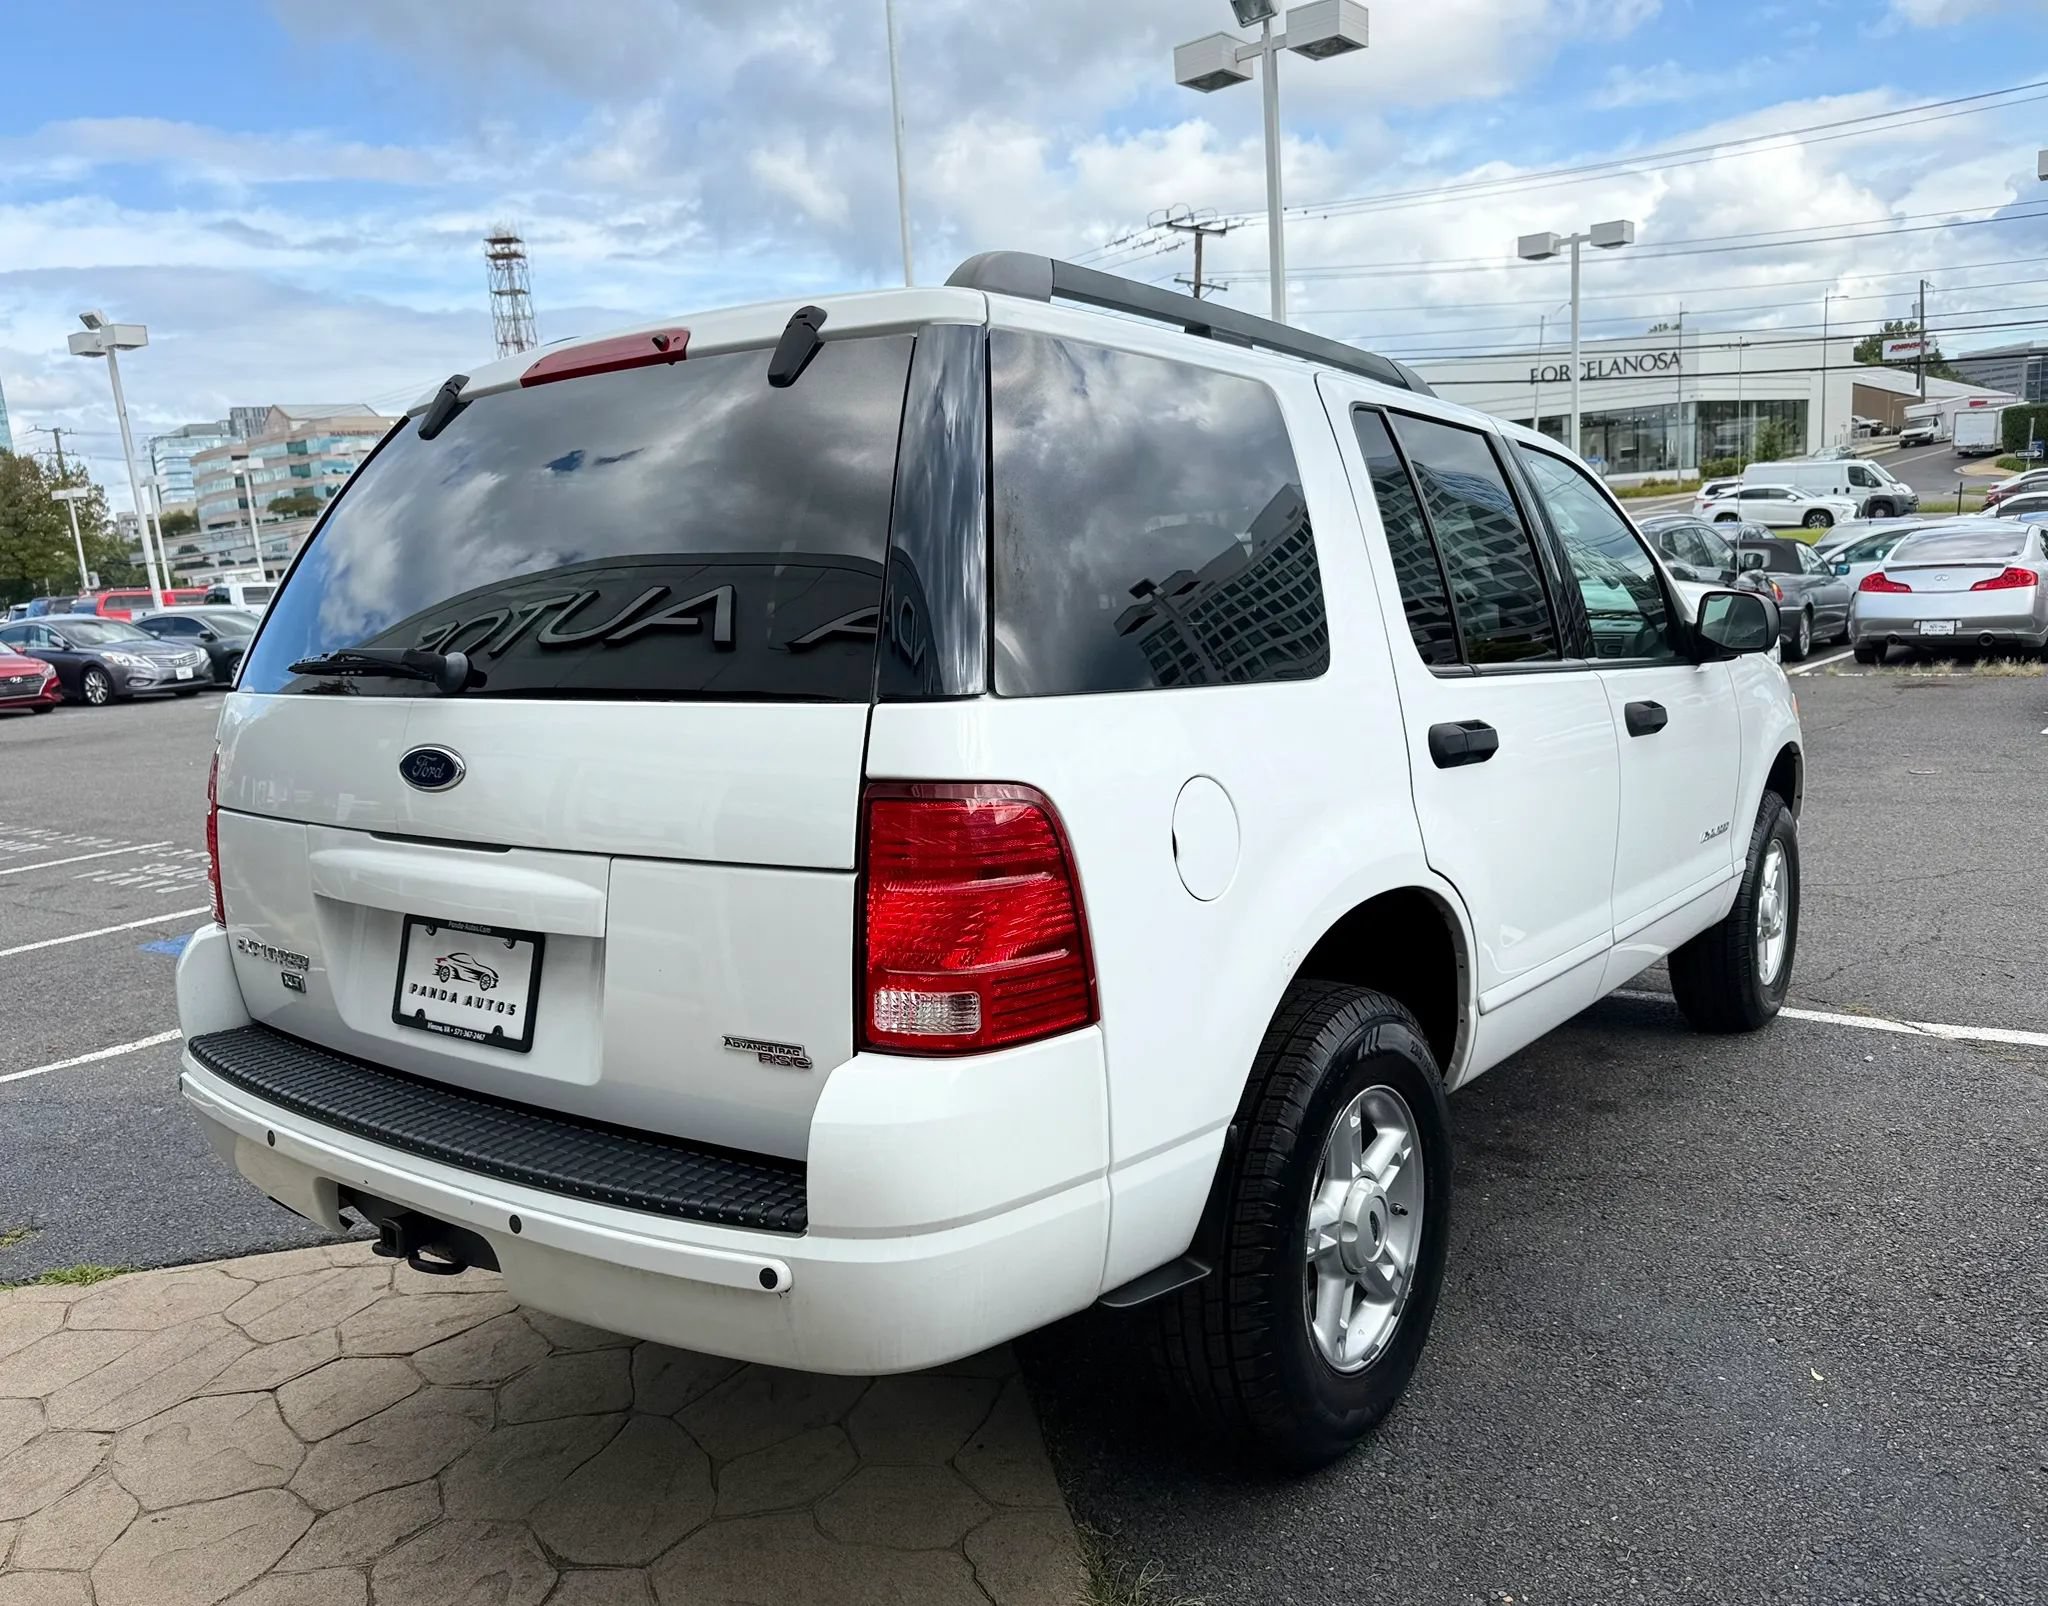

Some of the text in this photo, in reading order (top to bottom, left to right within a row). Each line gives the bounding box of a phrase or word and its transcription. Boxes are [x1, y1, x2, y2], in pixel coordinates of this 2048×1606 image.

[412, 755, 444, 778] Ford
[408, 983, 517, 1016] PANDA AUTOS
[758, 1052, 813, 1069] RSC
